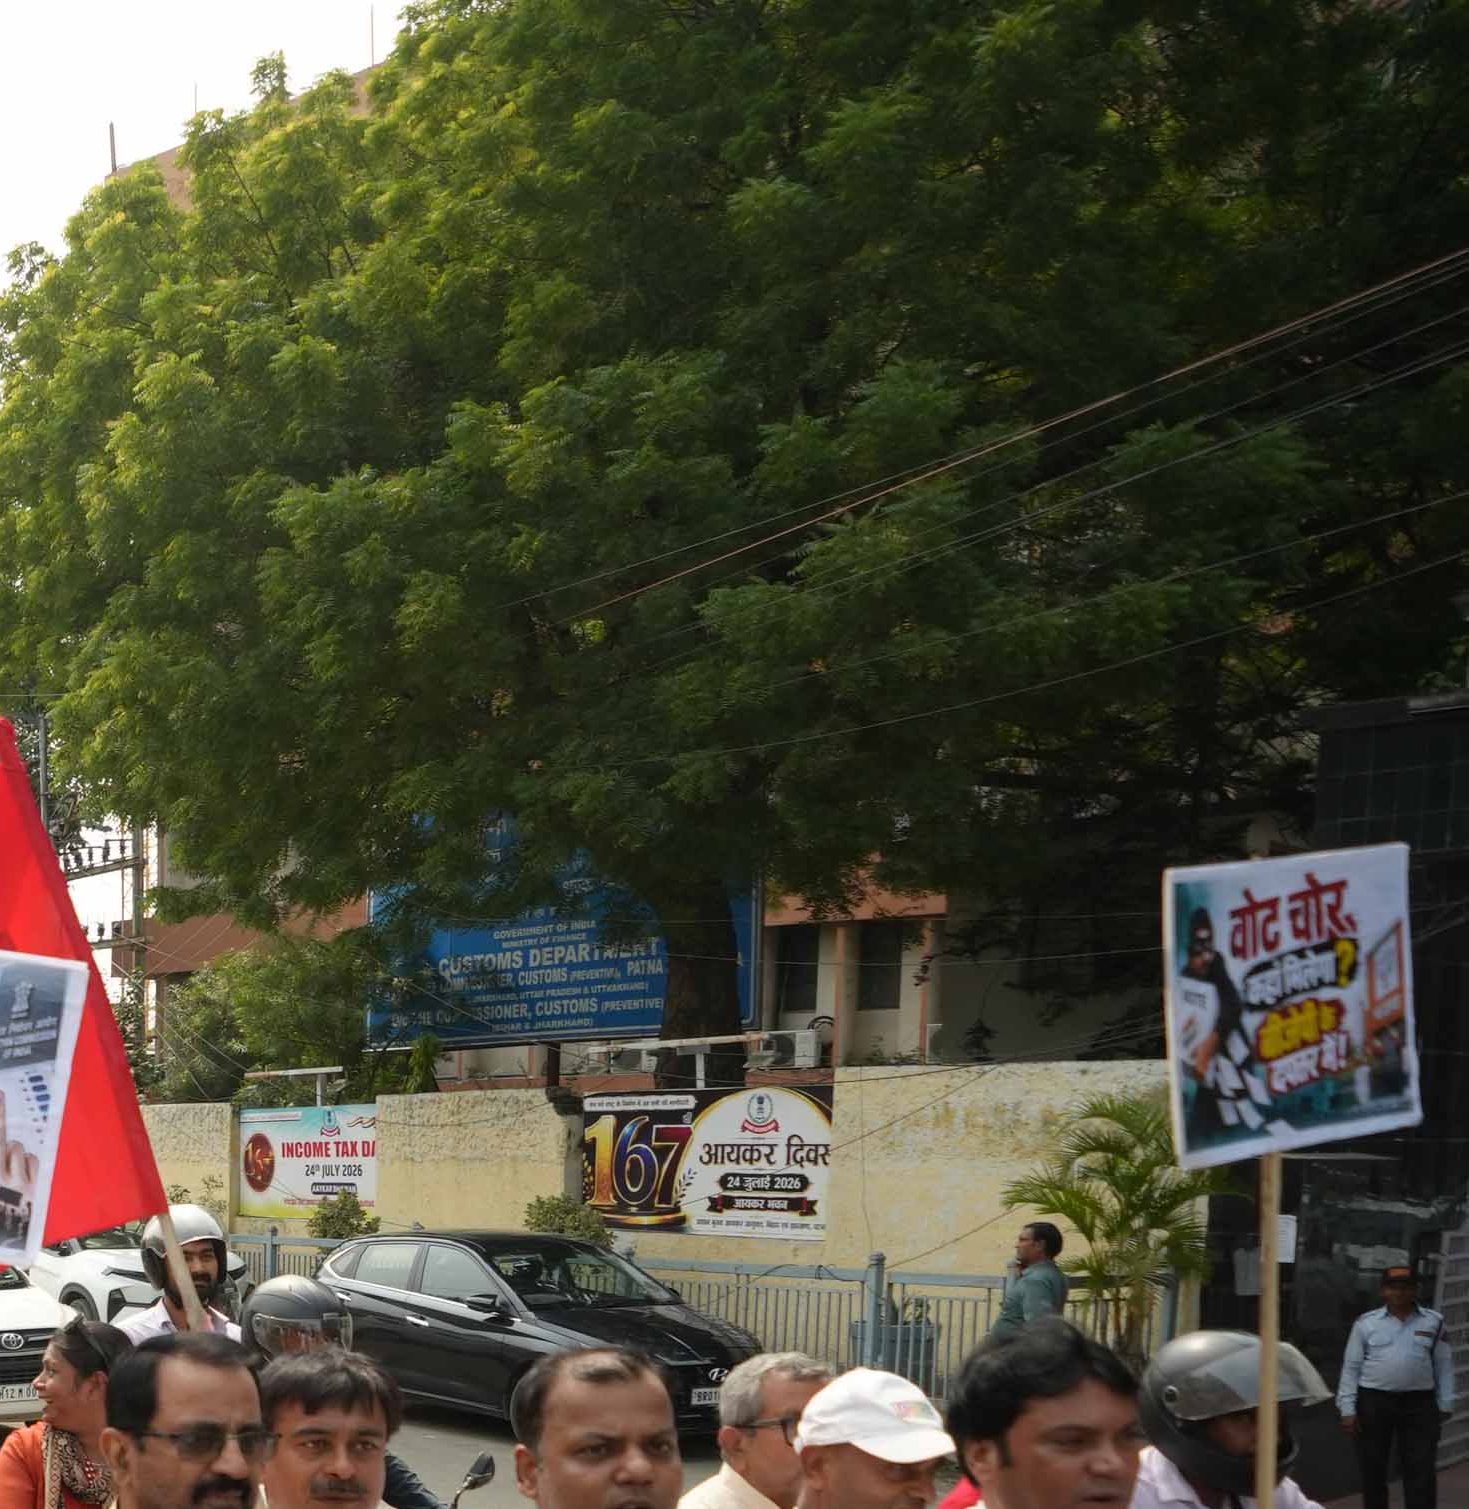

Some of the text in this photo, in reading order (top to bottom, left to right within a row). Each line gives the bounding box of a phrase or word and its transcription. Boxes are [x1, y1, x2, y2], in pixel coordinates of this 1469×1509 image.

[493, 919, 597, 940] GOVERNMENT OF INDIA
[1229, 887, 1282, 960] वोट
[438, 951, 524, 977] CUSTOMS
[518, 968, 568, 986] CUSTOMS
[535, 997, 599, 1016] CUSTOMS
[281, 1141, 331, 1158] INCOME
[333, 1140, 359, 1157] TAX
[699, 1142, 778, 1167] आयकर
[321, 1164, 341, 1179] JULY
[343, 1164, 363, 1177] 2026
[583, 1114, 695, 1209] 167
[727, 1174, 802, 1192] 24 जुलाई 2026
